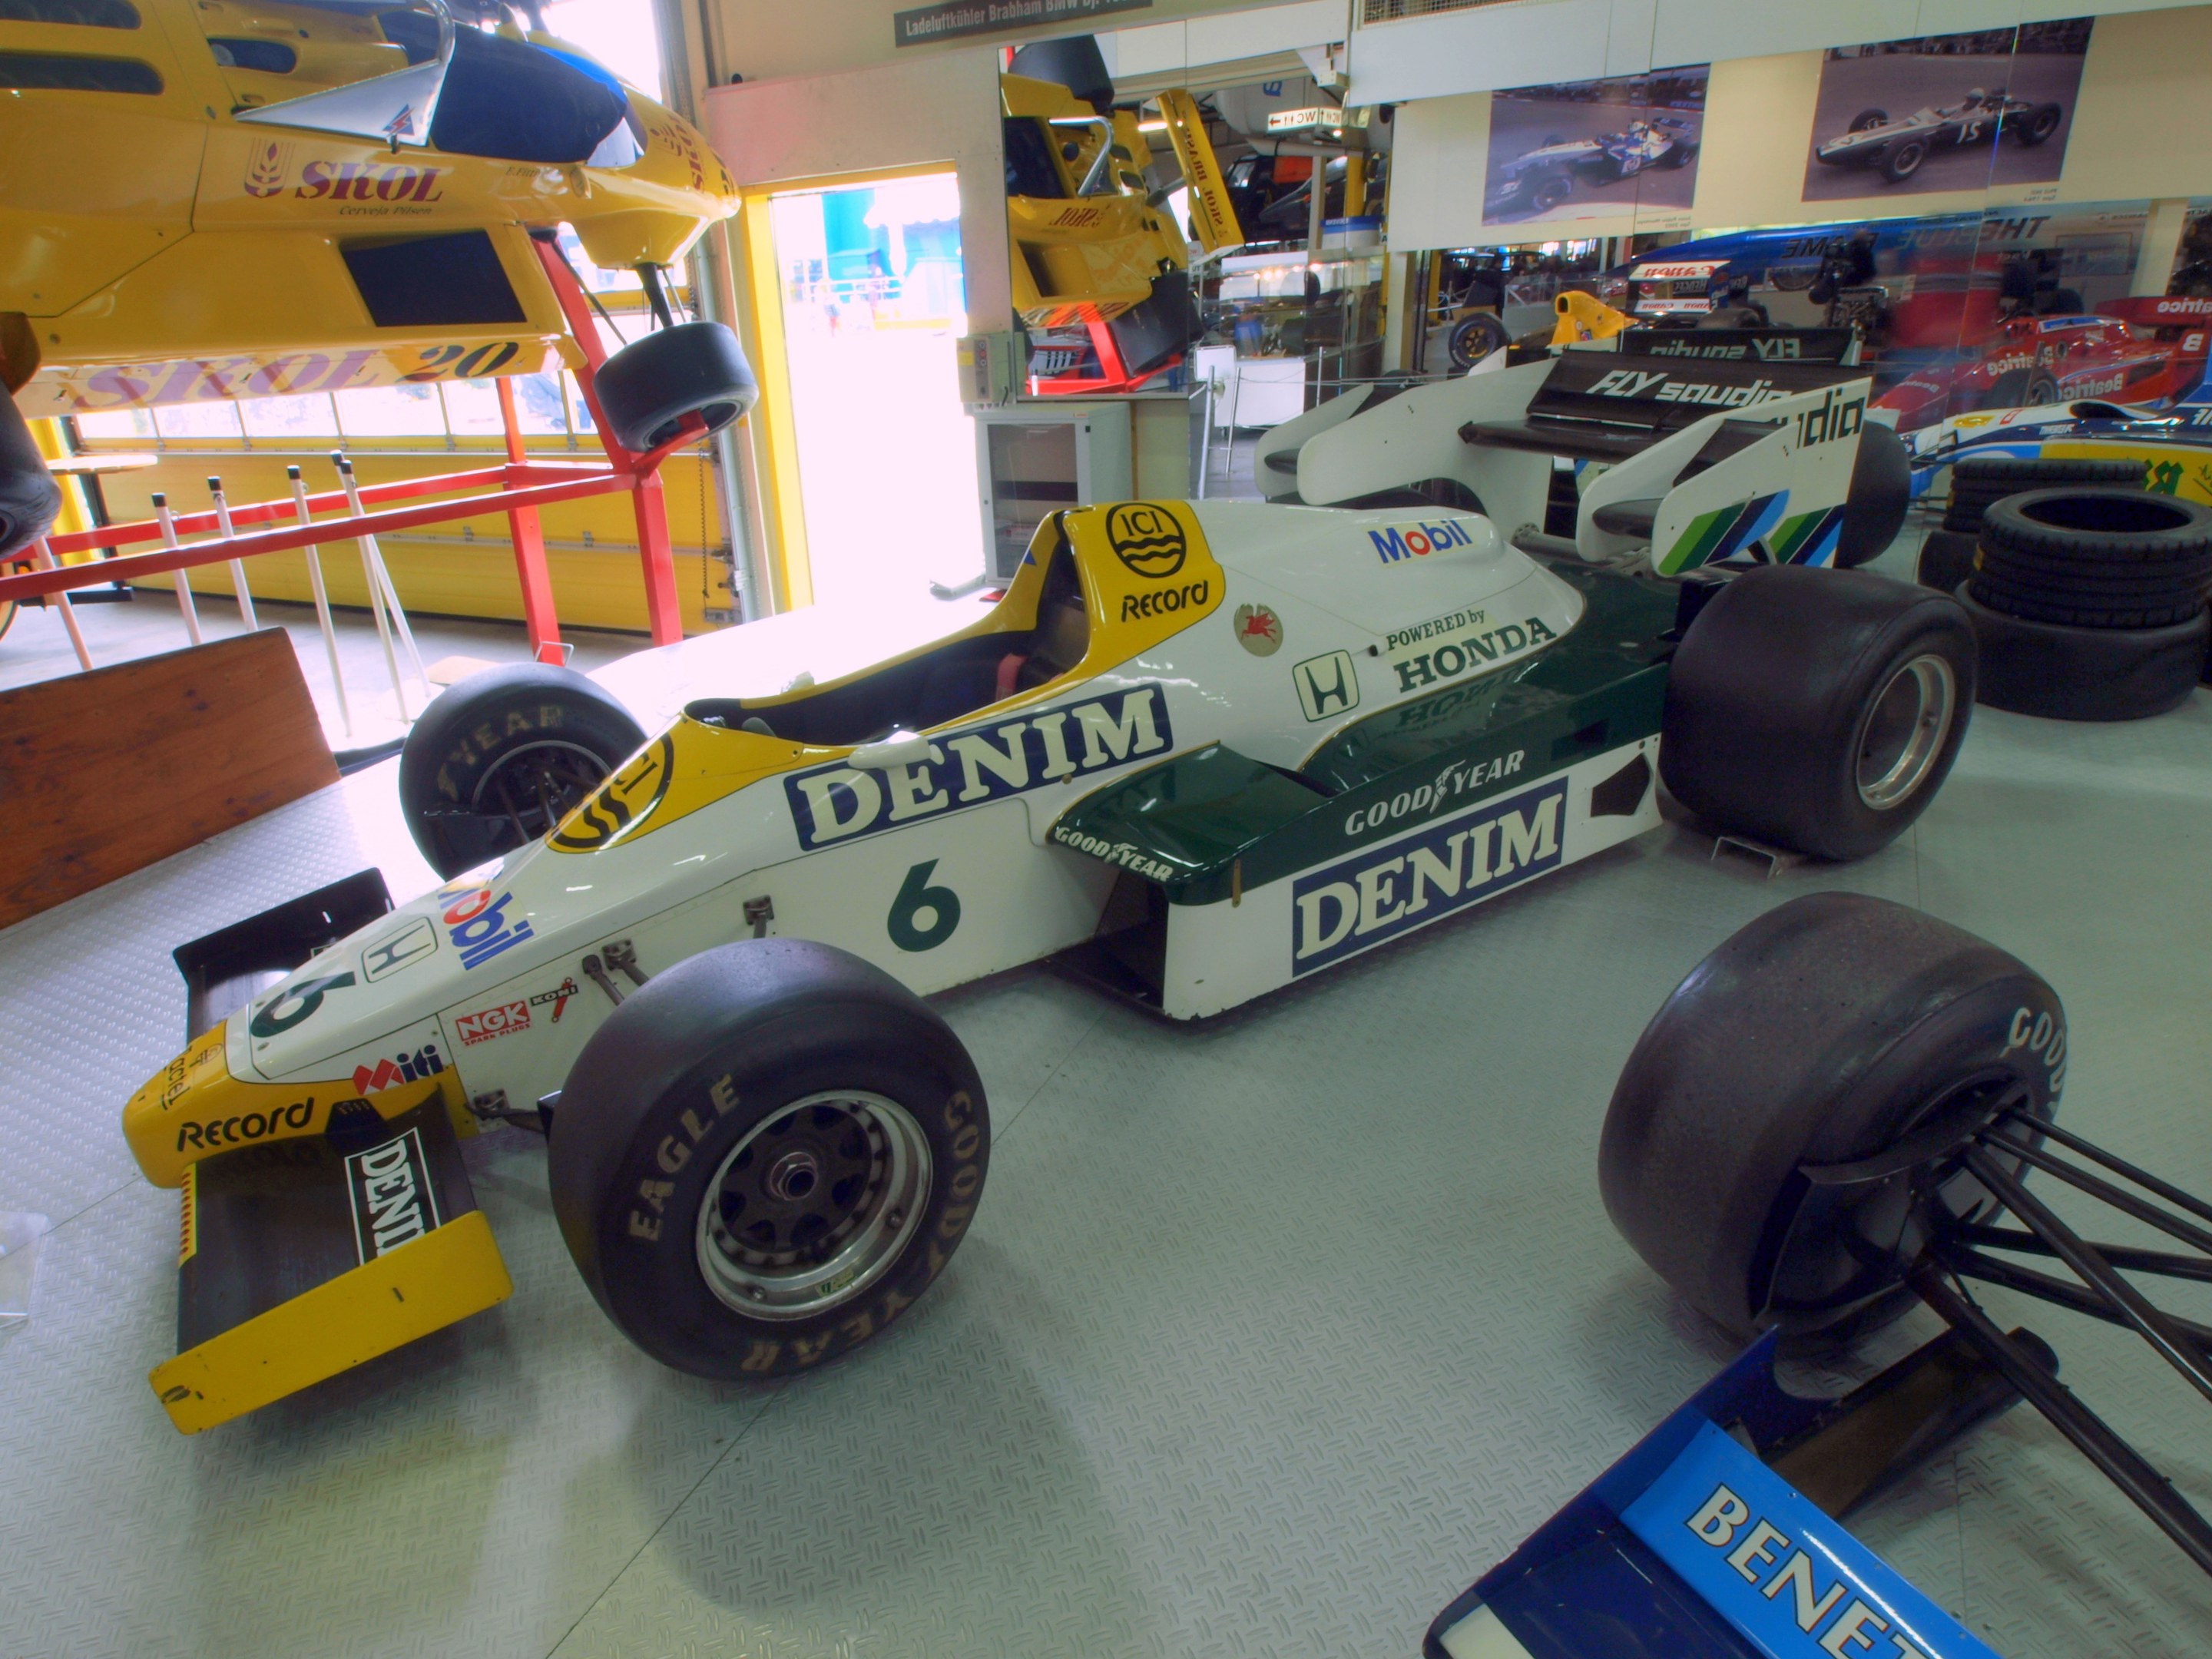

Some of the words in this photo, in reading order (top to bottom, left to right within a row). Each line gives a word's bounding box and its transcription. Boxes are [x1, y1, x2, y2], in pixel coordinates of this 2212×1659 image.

[906, 10, 985, 36] Ladeluftkühler
[989, 1, 1041, 22] Brabham
[295, 160, 443, 202] SKOL
[339, 206, 389, 216] Cerveja
[392, 206, 432, 215] Pilsen
[71, 348, 382, 409] SKOL
[396, 341, 520, 383] 20
[1586, 370, 1668, 397] FLY
[1120, 510, 1164, 537] ICI
[1368, 520, 1473, 564] Mobil
[1386, 612, 1466, 651] POWERED
[1467, 609, 1485, 624] by
[1393, 617, 1558, 693] HONDA
[796, 689, 1164, 843] DENIM
[1296, 793, 1564, 960] DENIM
[886, 858, 962, 952] 6
[532, 985, 578, 1005] KONI
[458, 1002, 530, 1040] NGK
[464, 1033, 497, 1046] SPARK
[499, 1022, 531, 1036] PLUGS
[628, 1074, 741, 1243] EAGLE
